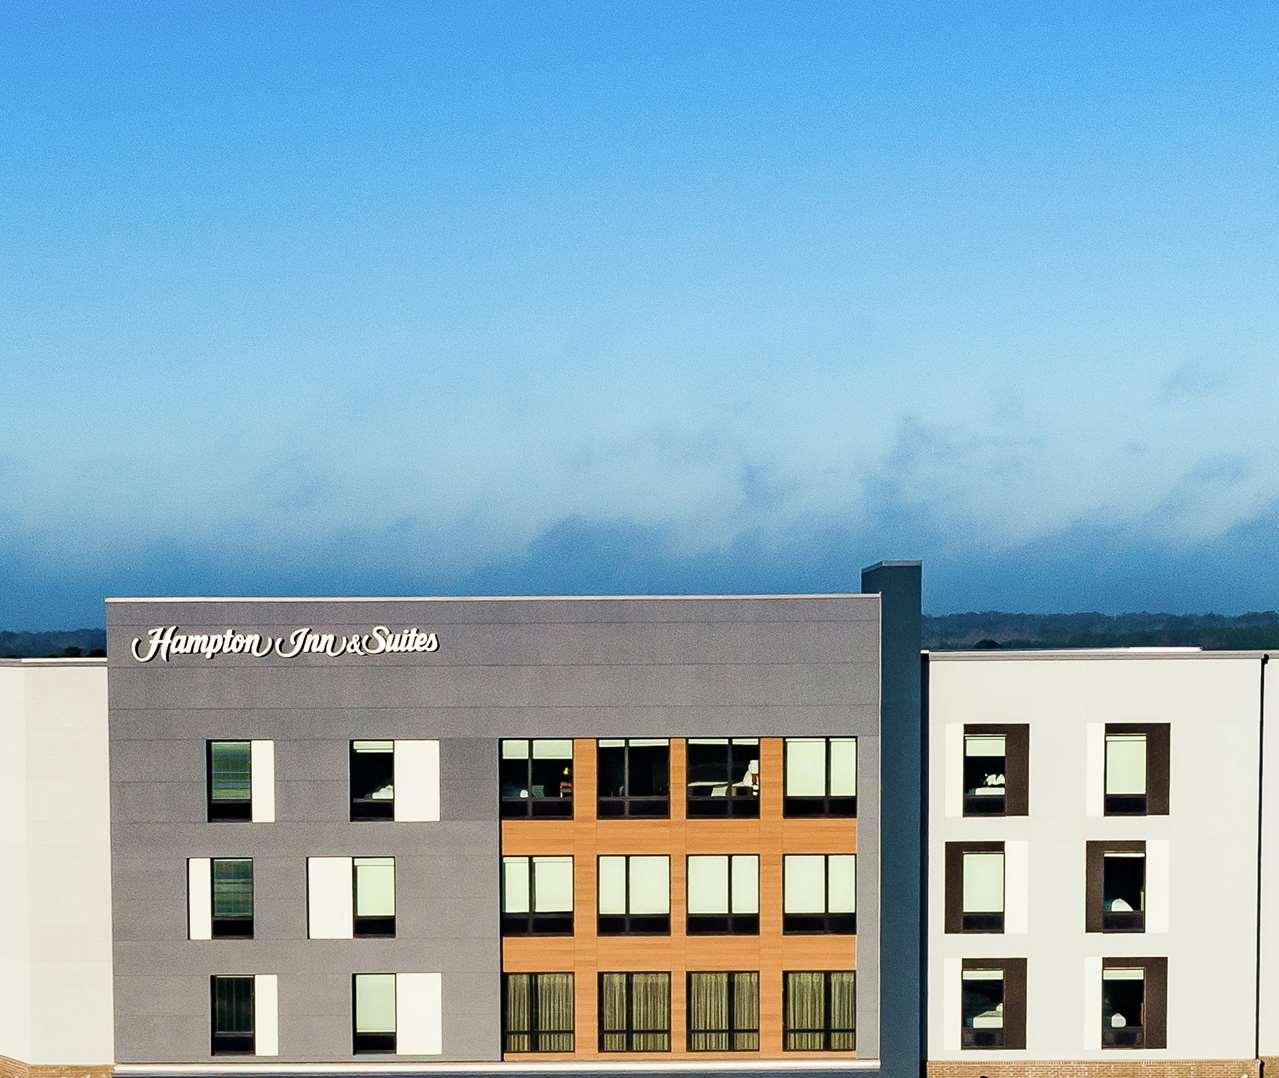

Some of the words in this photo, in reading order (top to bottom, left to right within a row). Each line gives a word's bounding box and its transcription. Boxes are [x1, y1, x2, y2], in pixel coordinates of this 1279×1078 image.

[131, 625, 274, 663] Hampton
[275, 627, 348, 658] Inn
[361, 625, 440, 656] Suites
